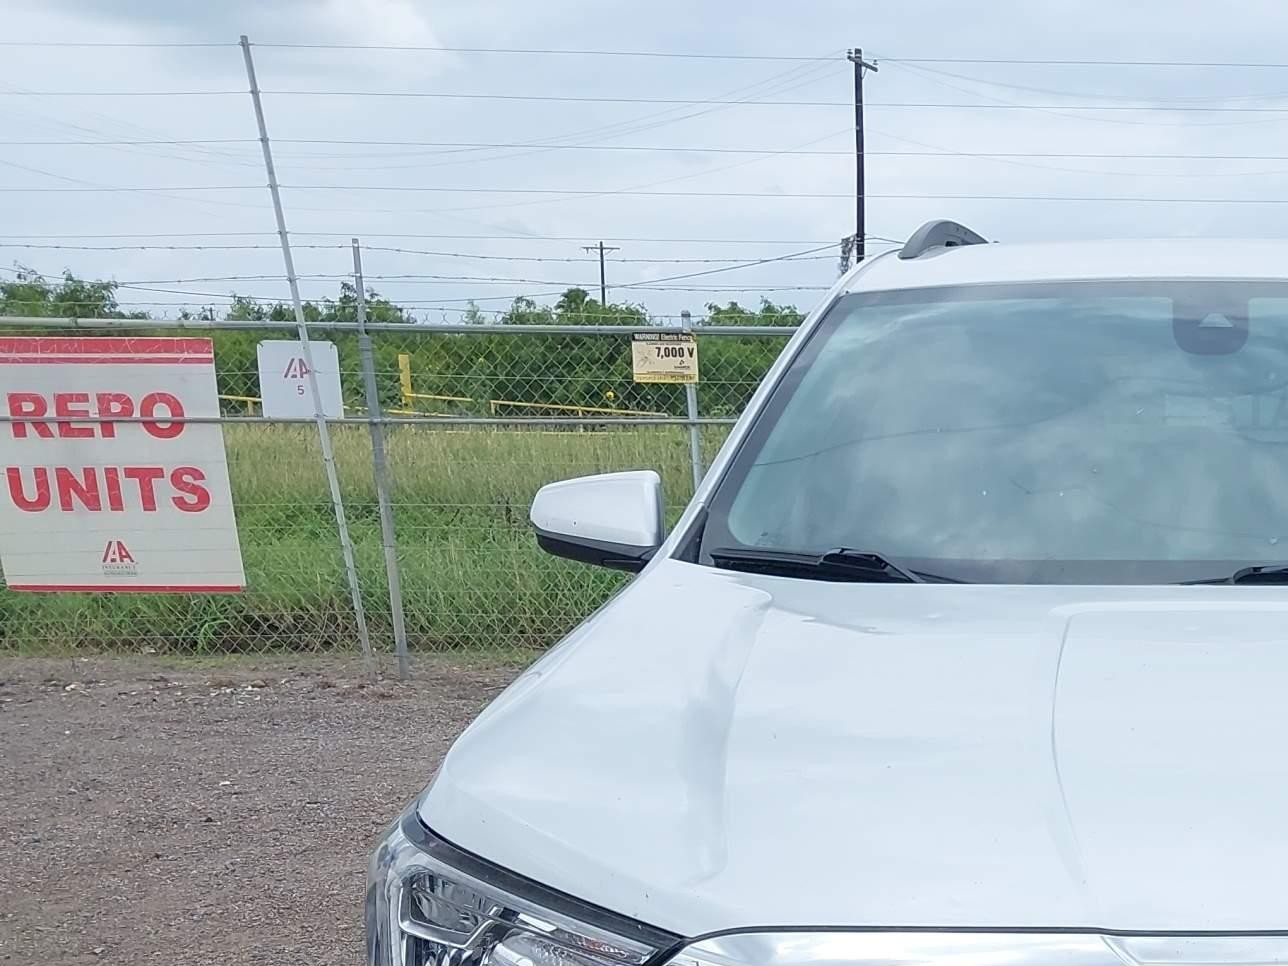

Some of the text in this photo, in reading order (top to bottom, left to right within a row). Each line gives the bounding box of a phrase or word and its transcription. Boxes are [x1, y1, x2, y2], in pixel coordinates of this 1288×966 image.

[655, 346, 695, 359] 7,000 V
[296, 385, 305, 396] 5
[7, 392, 186, 439] REPO
[6, 467, 211, 512] UNITS
